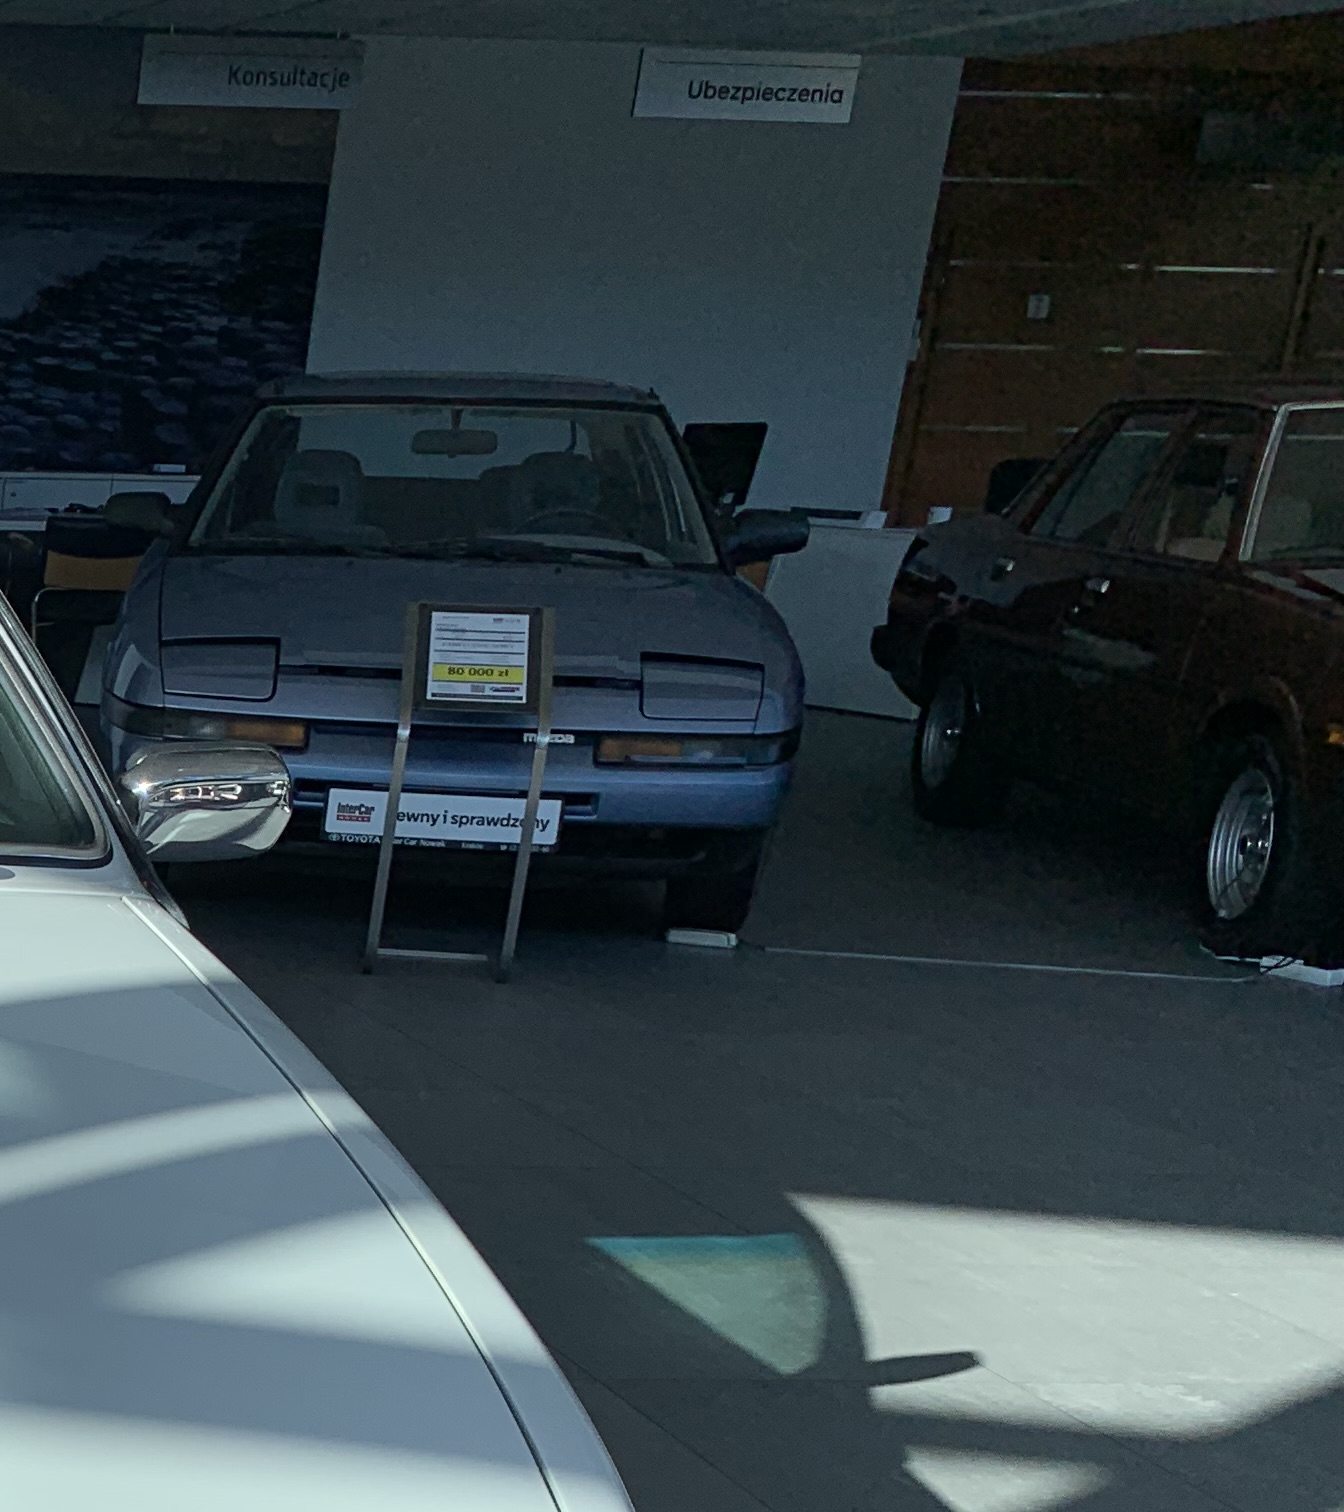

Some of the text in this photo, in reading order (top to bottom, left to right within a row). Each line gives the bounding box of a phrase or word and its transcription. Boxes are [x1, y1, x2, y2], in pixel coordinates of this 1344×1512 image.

[227, 64, 351, 94] Konsultacje
[688, 79, 844, 104] Ubezpieczenia
[448, 667, 465, 676] 80
[468, 668, 494, 677] 000
[523, 733, 575, 744] mzda
[337, 802, 375, 815] InterCar
[396, 811, 439, 826] ewny
[443, 810, 448, 824] i
[341, 834, 381, 844] TOYOTA
